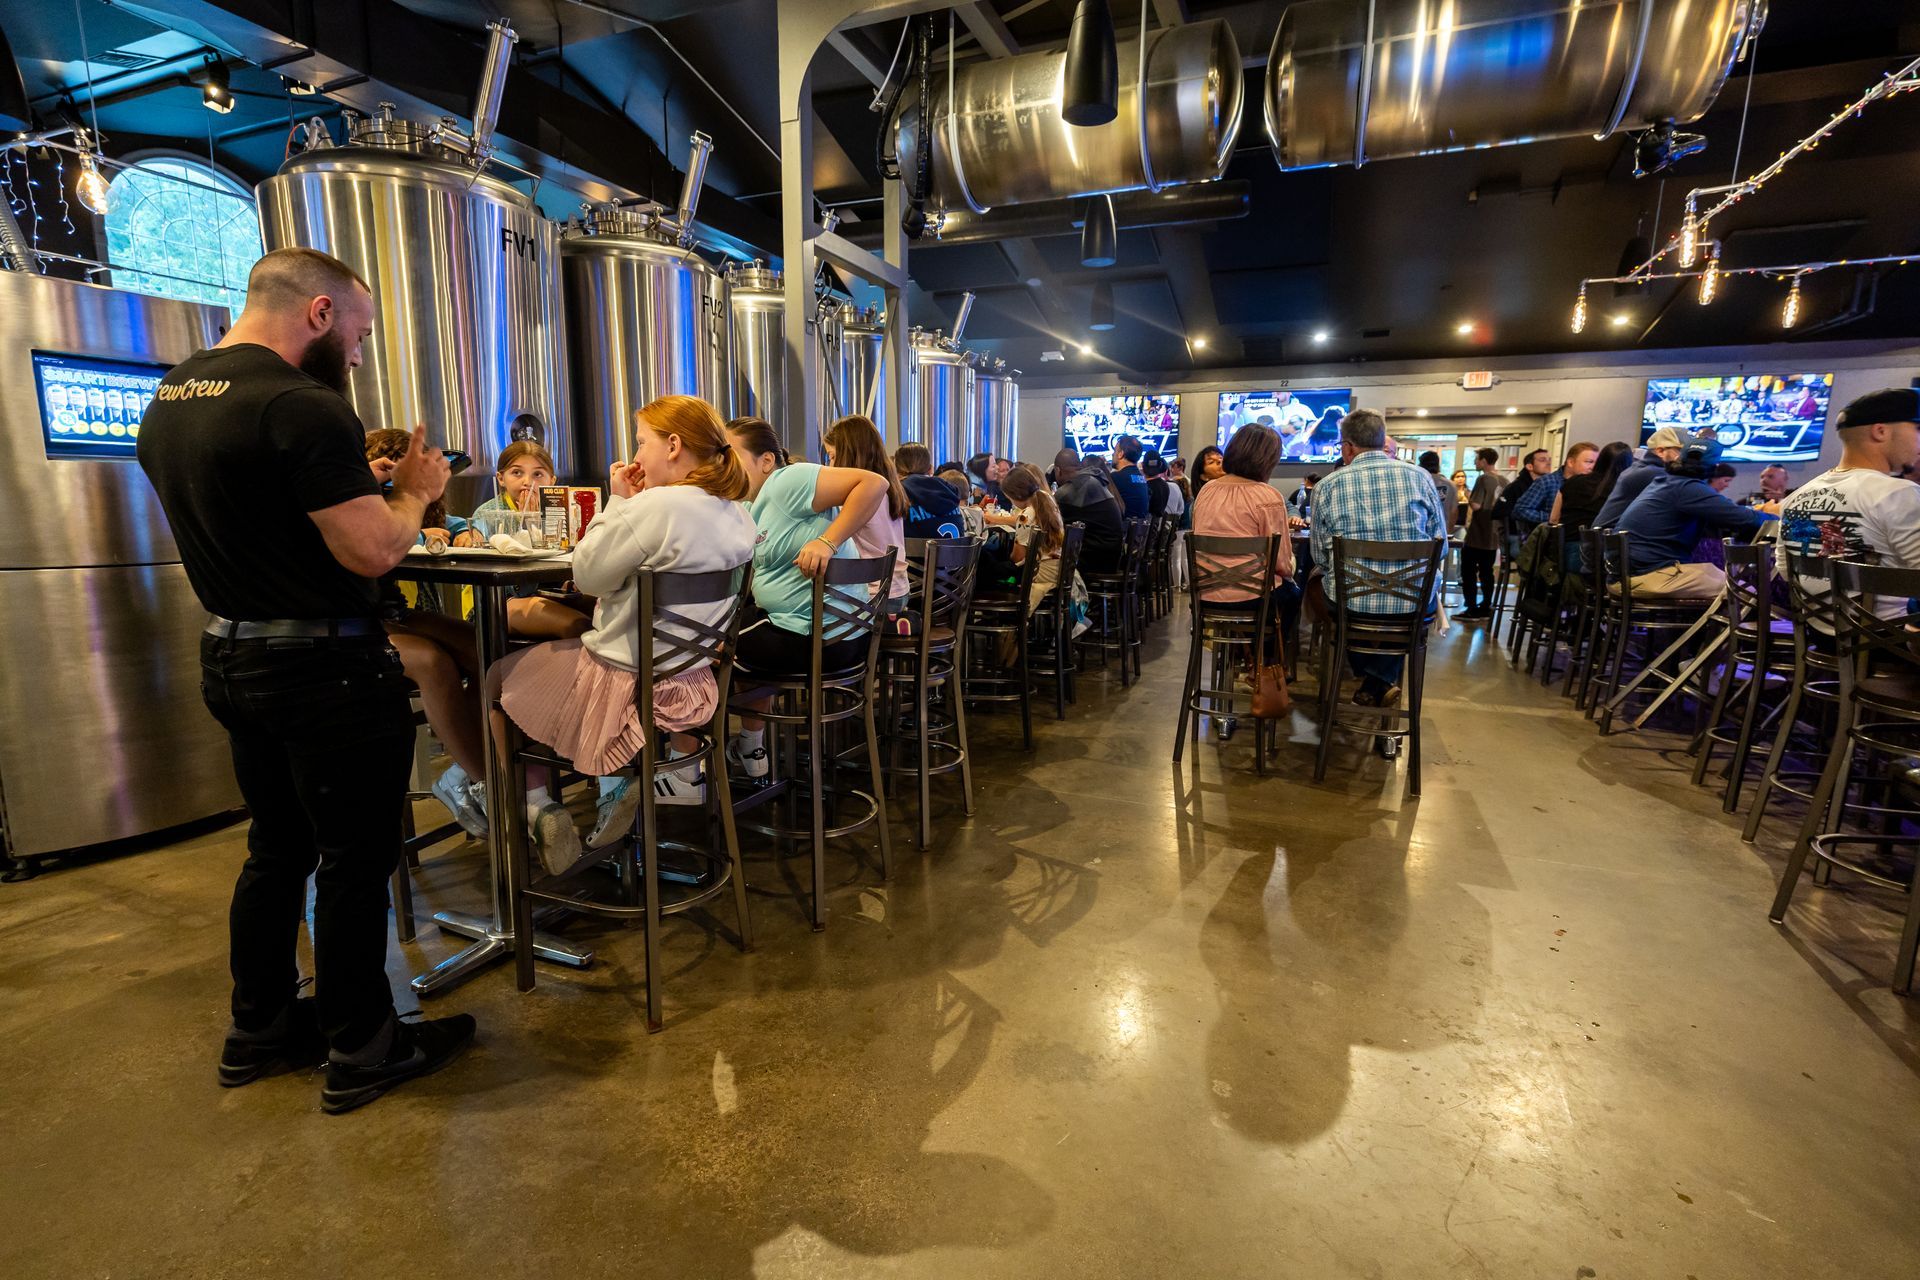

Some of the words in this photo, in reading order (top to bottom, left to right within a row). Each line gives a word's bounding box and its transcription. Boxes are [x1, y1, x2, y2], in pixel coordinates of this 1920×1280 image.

[501, 227, 535, 261] FV1
[702, 294, 723, 319] FV2
[1469, 371, 1489, 386] EXIT
[1718, 430, 1742, 442] TNT
